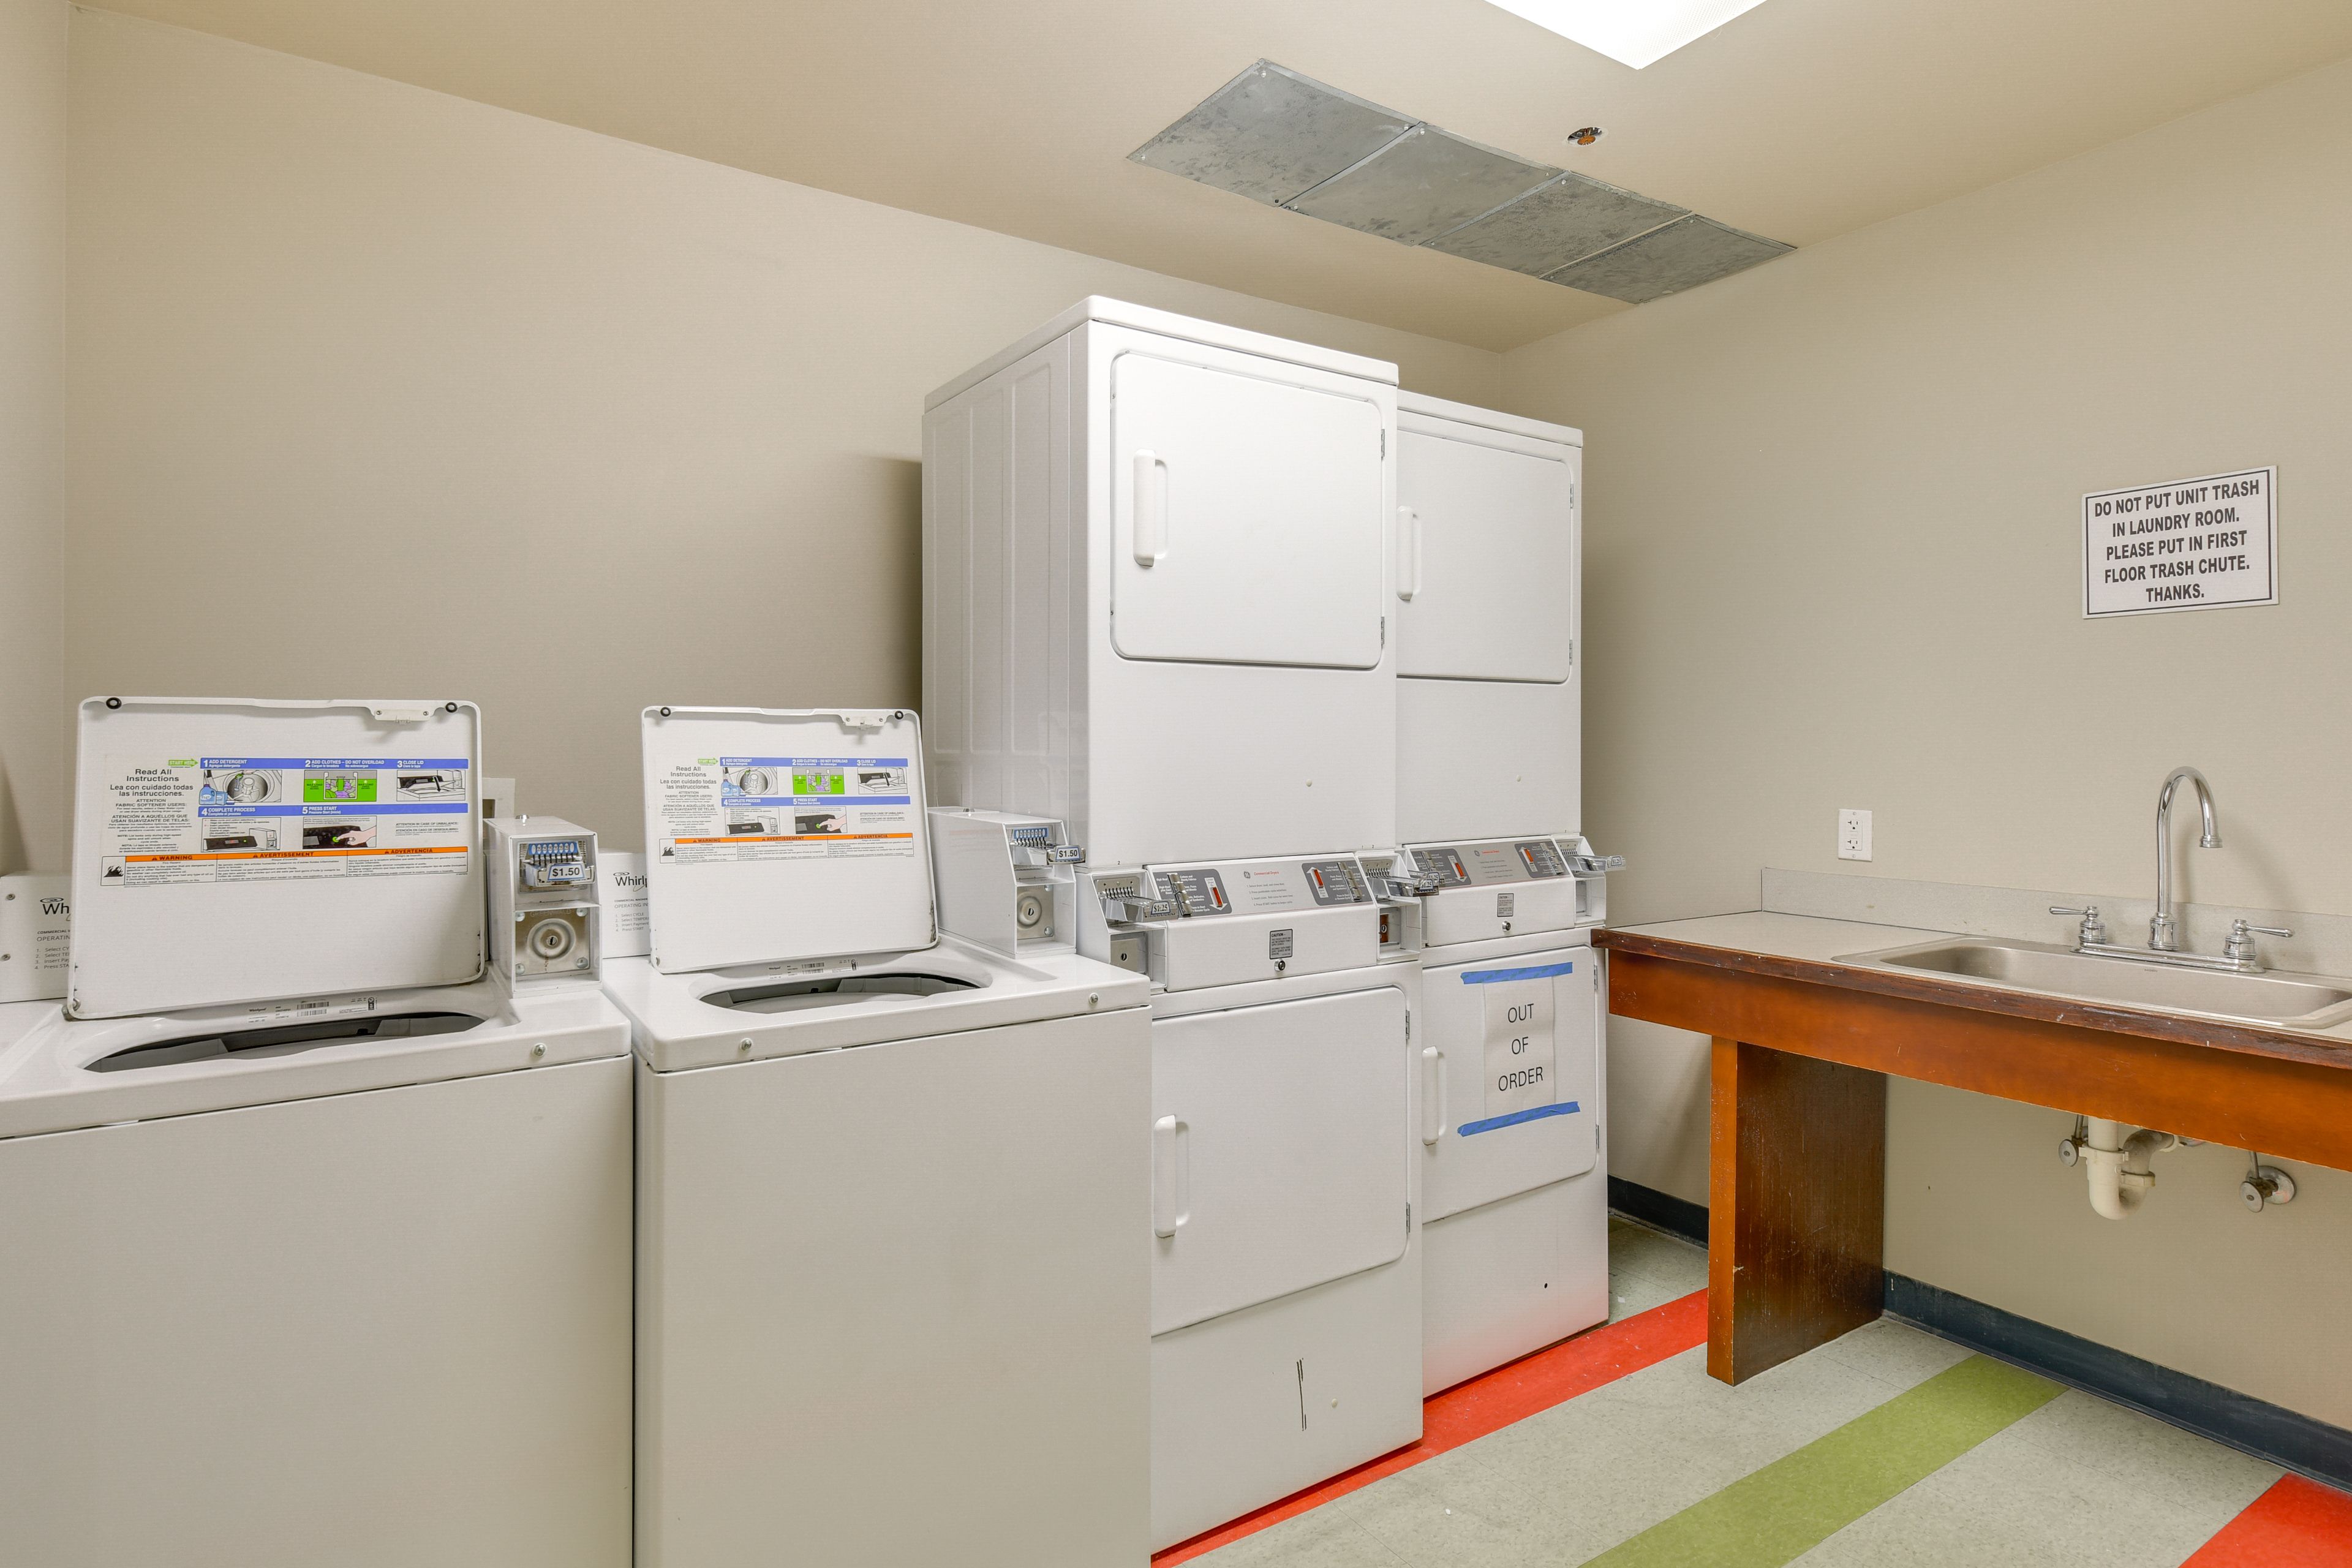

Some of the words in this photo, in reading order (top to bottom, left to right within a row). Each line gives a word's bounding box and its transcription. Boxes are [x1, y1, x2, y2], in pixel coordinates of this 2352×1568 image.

[2095, 502, 2111, 517] DO
[2116, 497, 2141, 513] NOT
[2146, 493, 2171, 510] PUT
[2176, 488, 2207, 505] UNIT
[2212, 480, 2260, 500] TRASH
[2113, 522, 2125, 537] IN
[2130, 513, 2190, 535] LAUNDRY
[2195, 508, 2239, 527] ROOM.
[2106, 542, 2154, 560] PLEASE
[2158, 538, 2184, 554] PUT
[2190, 536, 2203, 551] IN
[2208, 530, 2247, 549] FIRST
[2105, 566, 2146, 583] FLOOR
[2150, 560, 2194, 578] TRASH
[2199, 555, 2250, 574] CHUTE.
[2146, 584, 2204, 602] THANKS.
[1508, 1003, 1534, 1023] OUT
[1512, 1036, 1528, 1054] OF
[1499, 1066, 1543, 1091] ORDER
